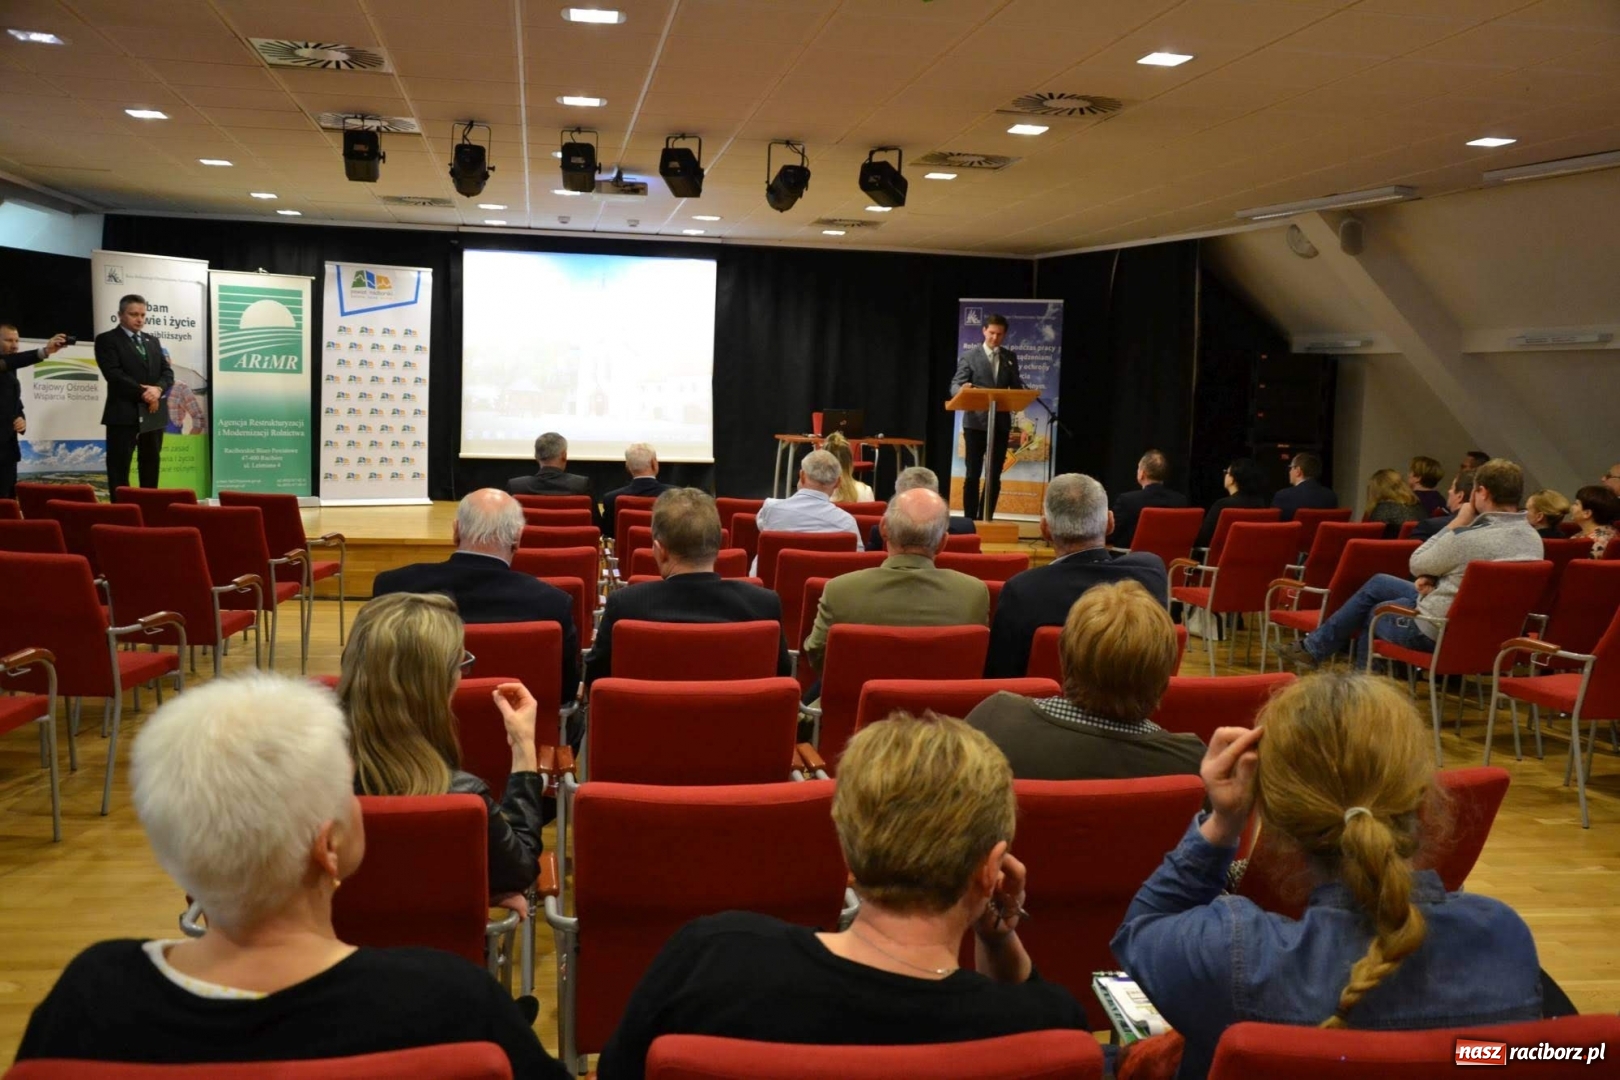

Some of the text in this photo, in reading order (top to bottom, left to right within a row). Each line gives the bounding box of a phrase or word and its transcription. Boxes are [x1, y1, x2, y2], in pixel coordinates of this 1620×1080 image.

[146, 301, 169, 313] bam
[170, 316, 196, 329] życie
[150, 331, 192, 342] ajbliższych
[234, 353, 298, 370] ARiMR
[33, 381, 98, 393] Krajowy Ośrodek
[33, 393, 99, 402] Wsparcia Rolnictwa
[218, 419, 305, 429] Agencja Restrukturyzacji
[222, 429, 269, 438] Modernizacji
[271, 429, 305, 437] Rolnictwa
